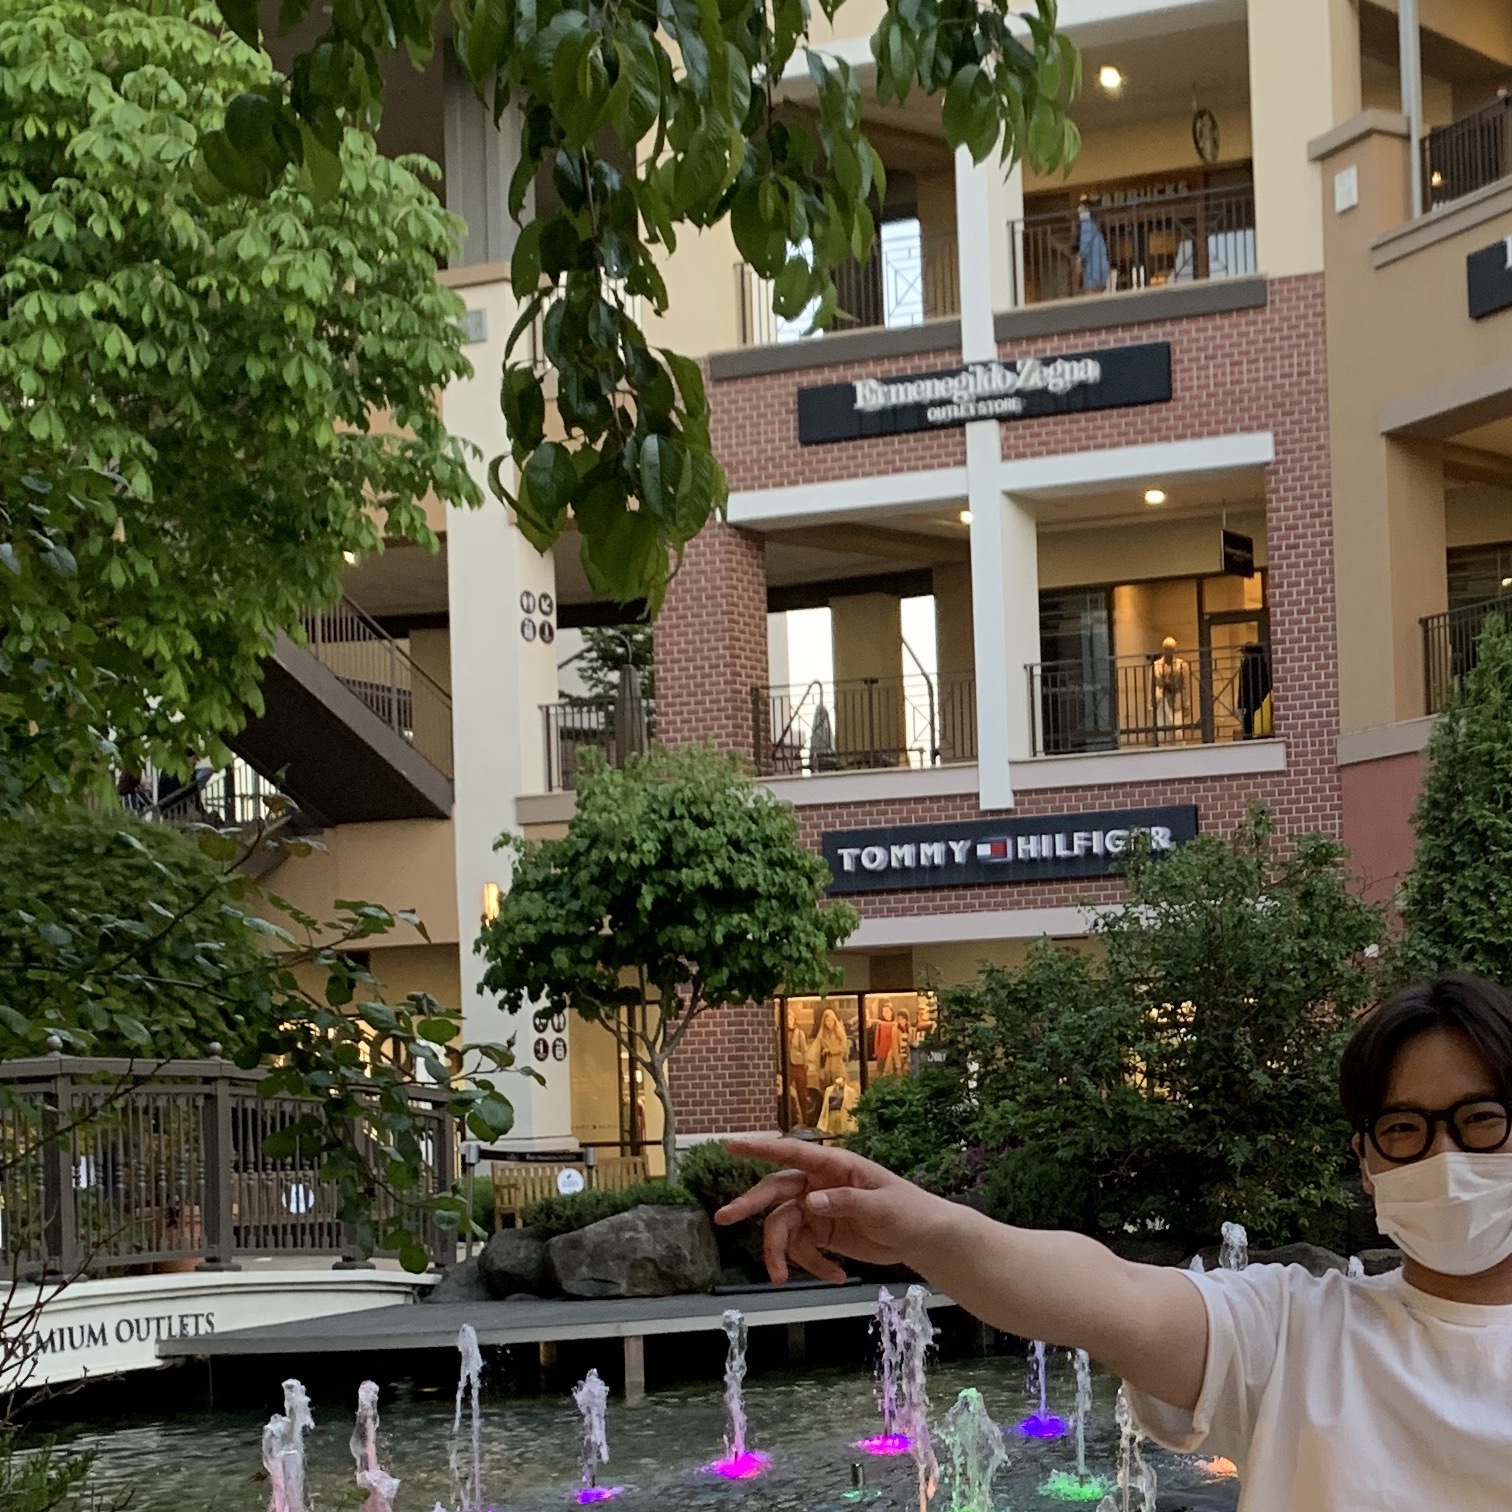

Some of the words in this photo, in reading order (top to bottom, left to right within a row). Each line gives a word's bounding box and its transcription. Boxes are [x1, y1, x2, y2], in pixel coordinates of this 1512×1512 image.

[853, 362, 1017, 411] Ermenegildo
[1014, 357, 1102, 395] Zegna
[837, 839, 971, 872] TOMMY
[115, 1312, 215, 1343] OUTLETS
